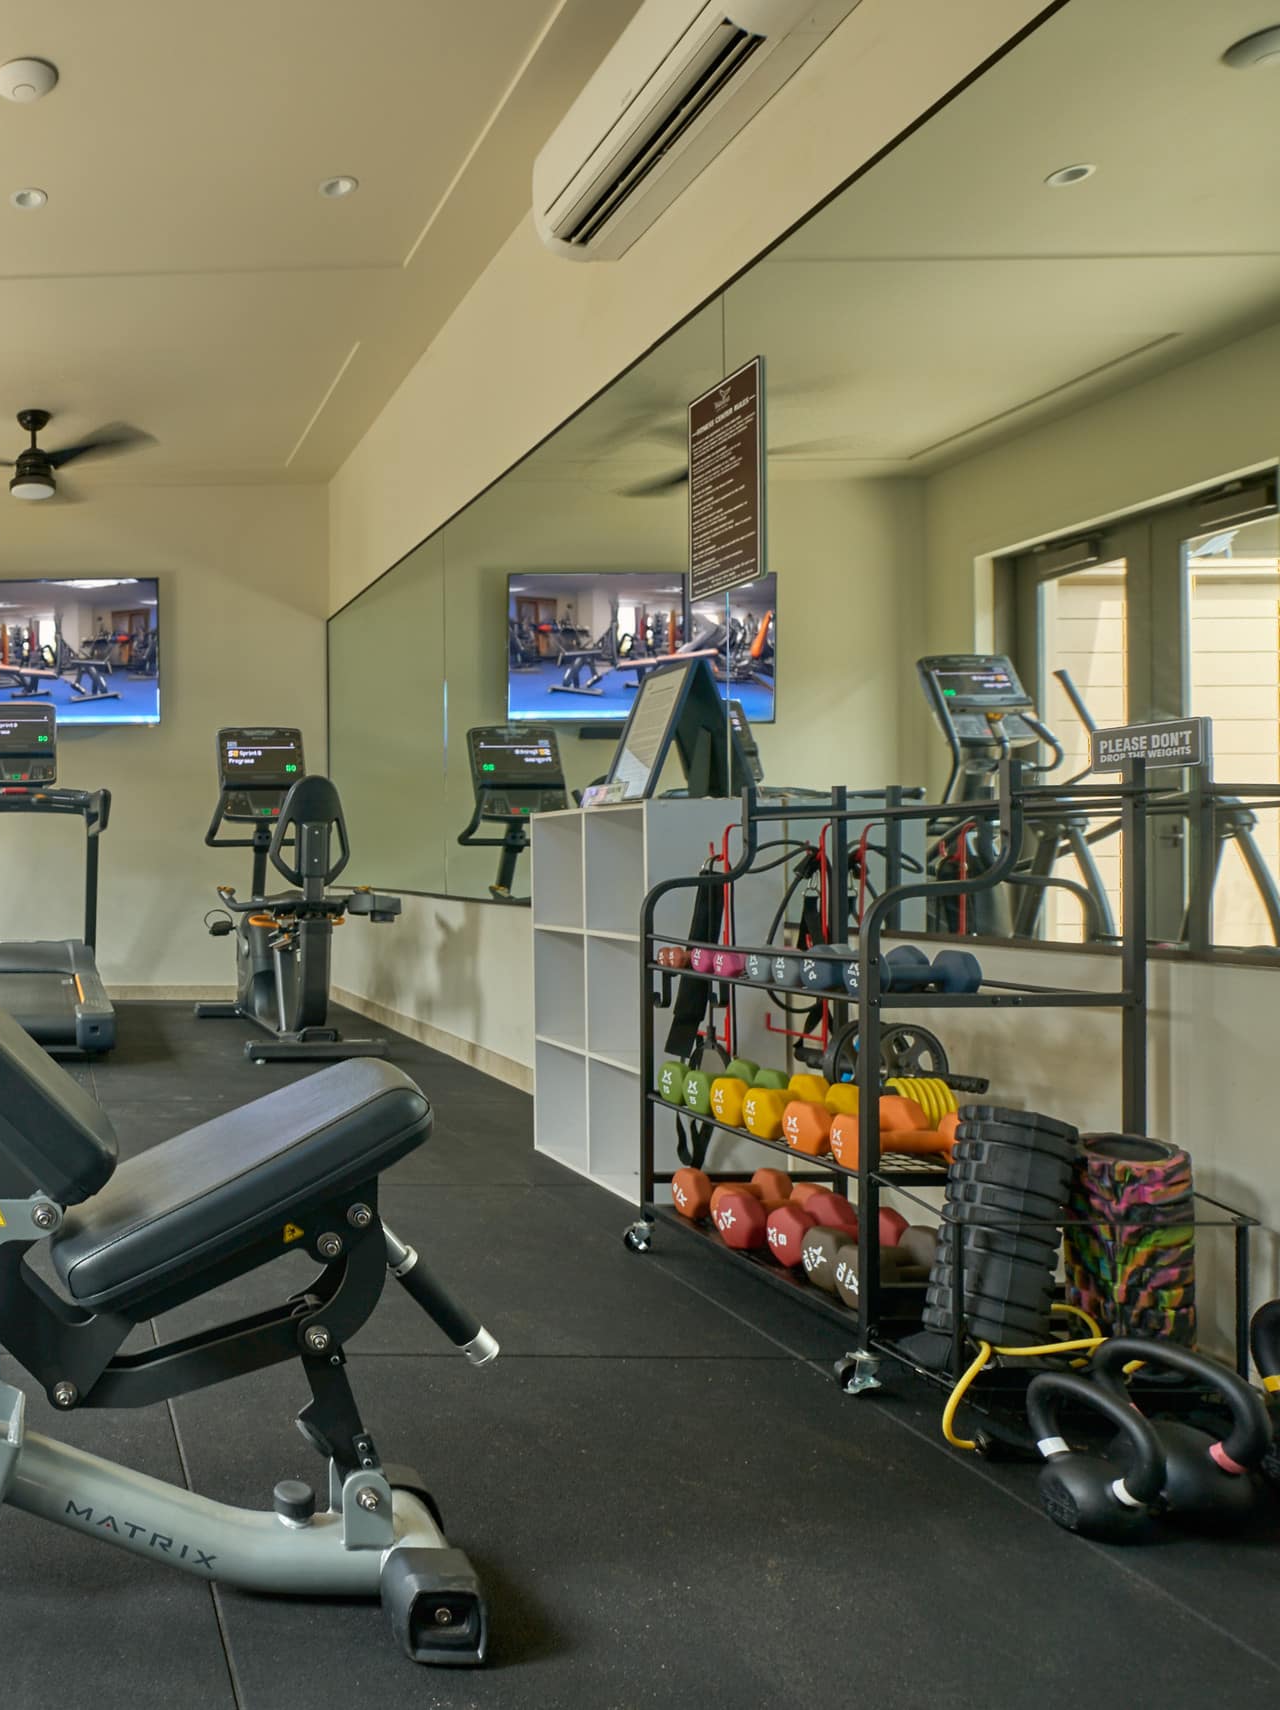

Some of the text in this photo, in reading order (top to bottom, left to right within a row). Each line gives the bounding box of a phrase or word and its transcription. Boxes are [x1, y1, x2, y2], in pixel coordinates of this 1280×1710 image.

[1099, 730, 1193, 754] PLEASE DON'T
[1099, 753, 1126, 763] DROP
[1147, 746, 1192, 759] WEIGHTS
[776, 970, 784, 979] 3
[790, 1135, 798, 1144] 7
[834, 1148, 842, 1158] 7
[65, 1500, 217, 1570] MATRIX
